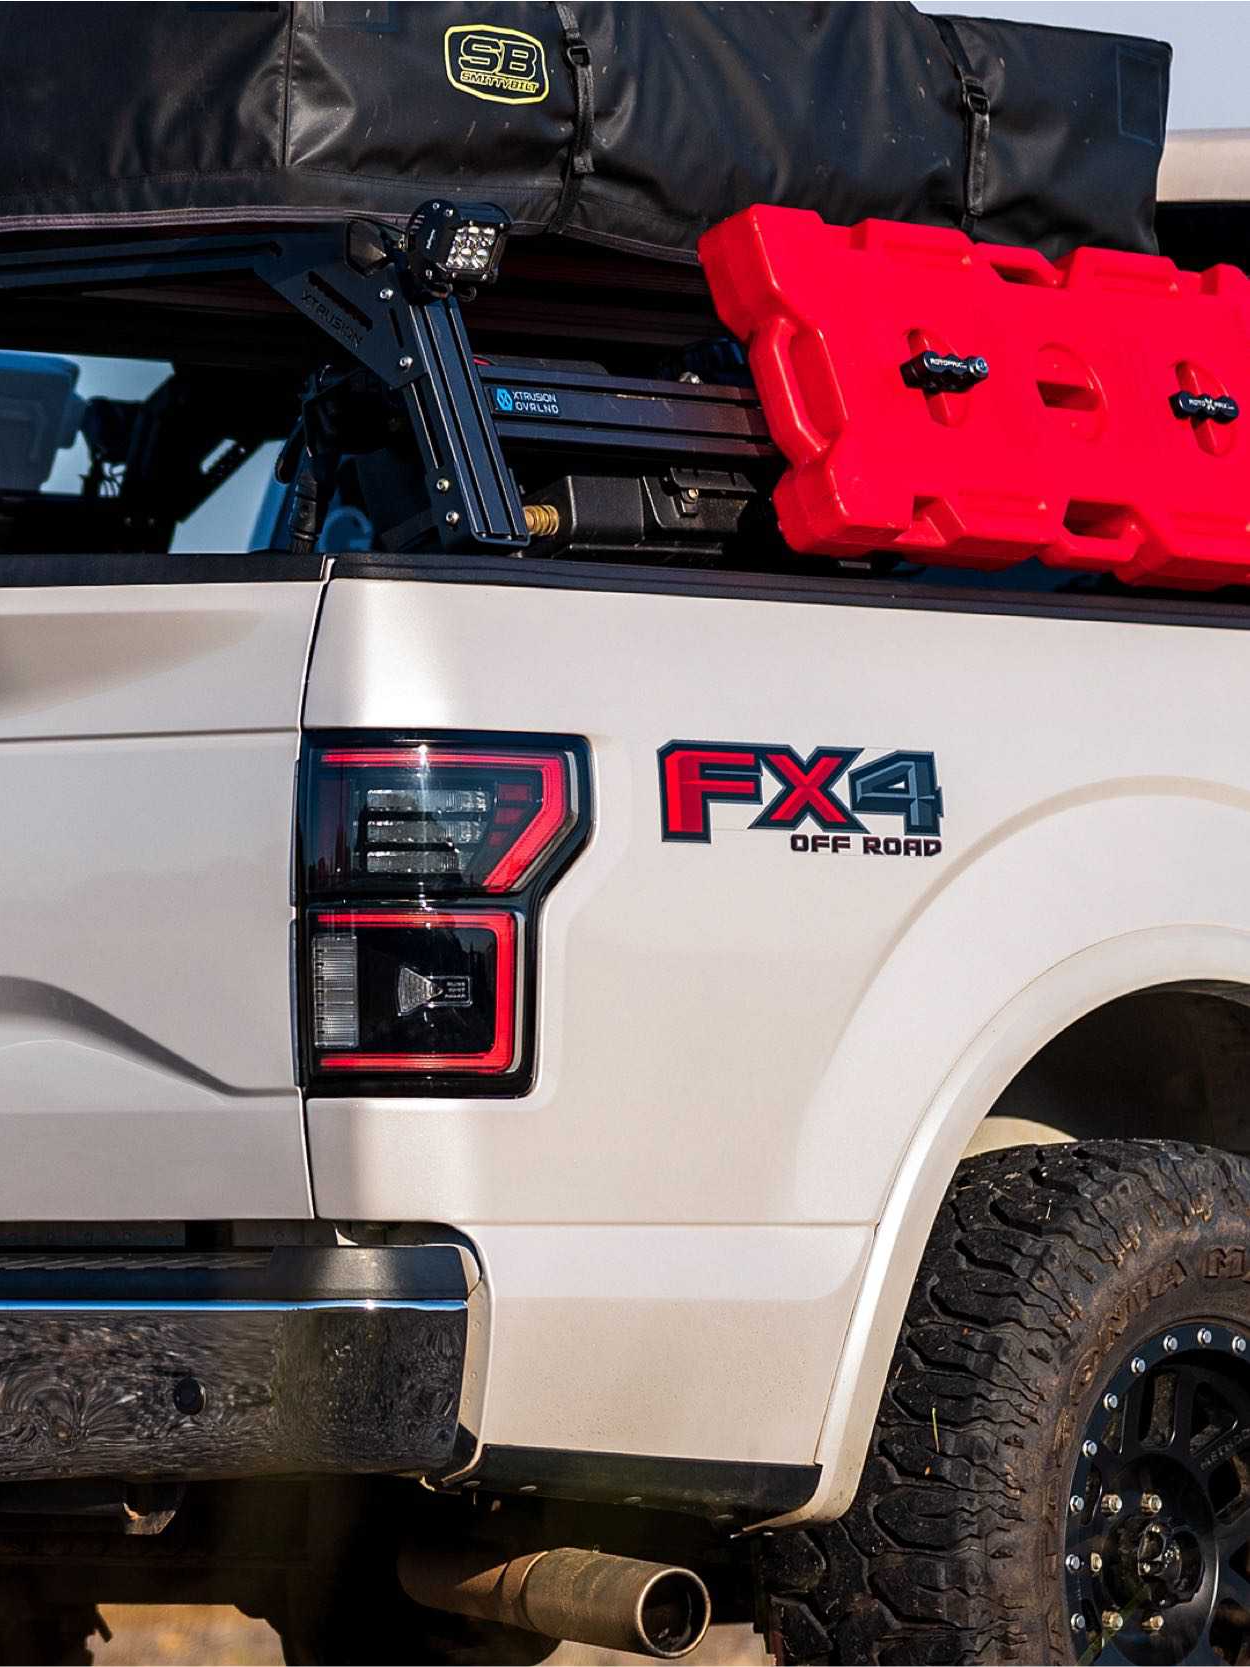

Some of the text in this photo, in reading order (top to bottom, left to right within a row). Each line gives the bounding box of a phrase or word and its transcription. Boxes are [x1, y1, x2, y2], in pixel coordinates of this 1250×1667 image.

[459, 35, 537, 80] SB
[460, 71, 539, 93] SMITTYBILT
[512, 391, 557, 402] XTRUSION
[515, 401, 559, 414] OVRLND
[656, 739, 944, 844] FX4
[790, 834, 942, 857] OFF ROAD
